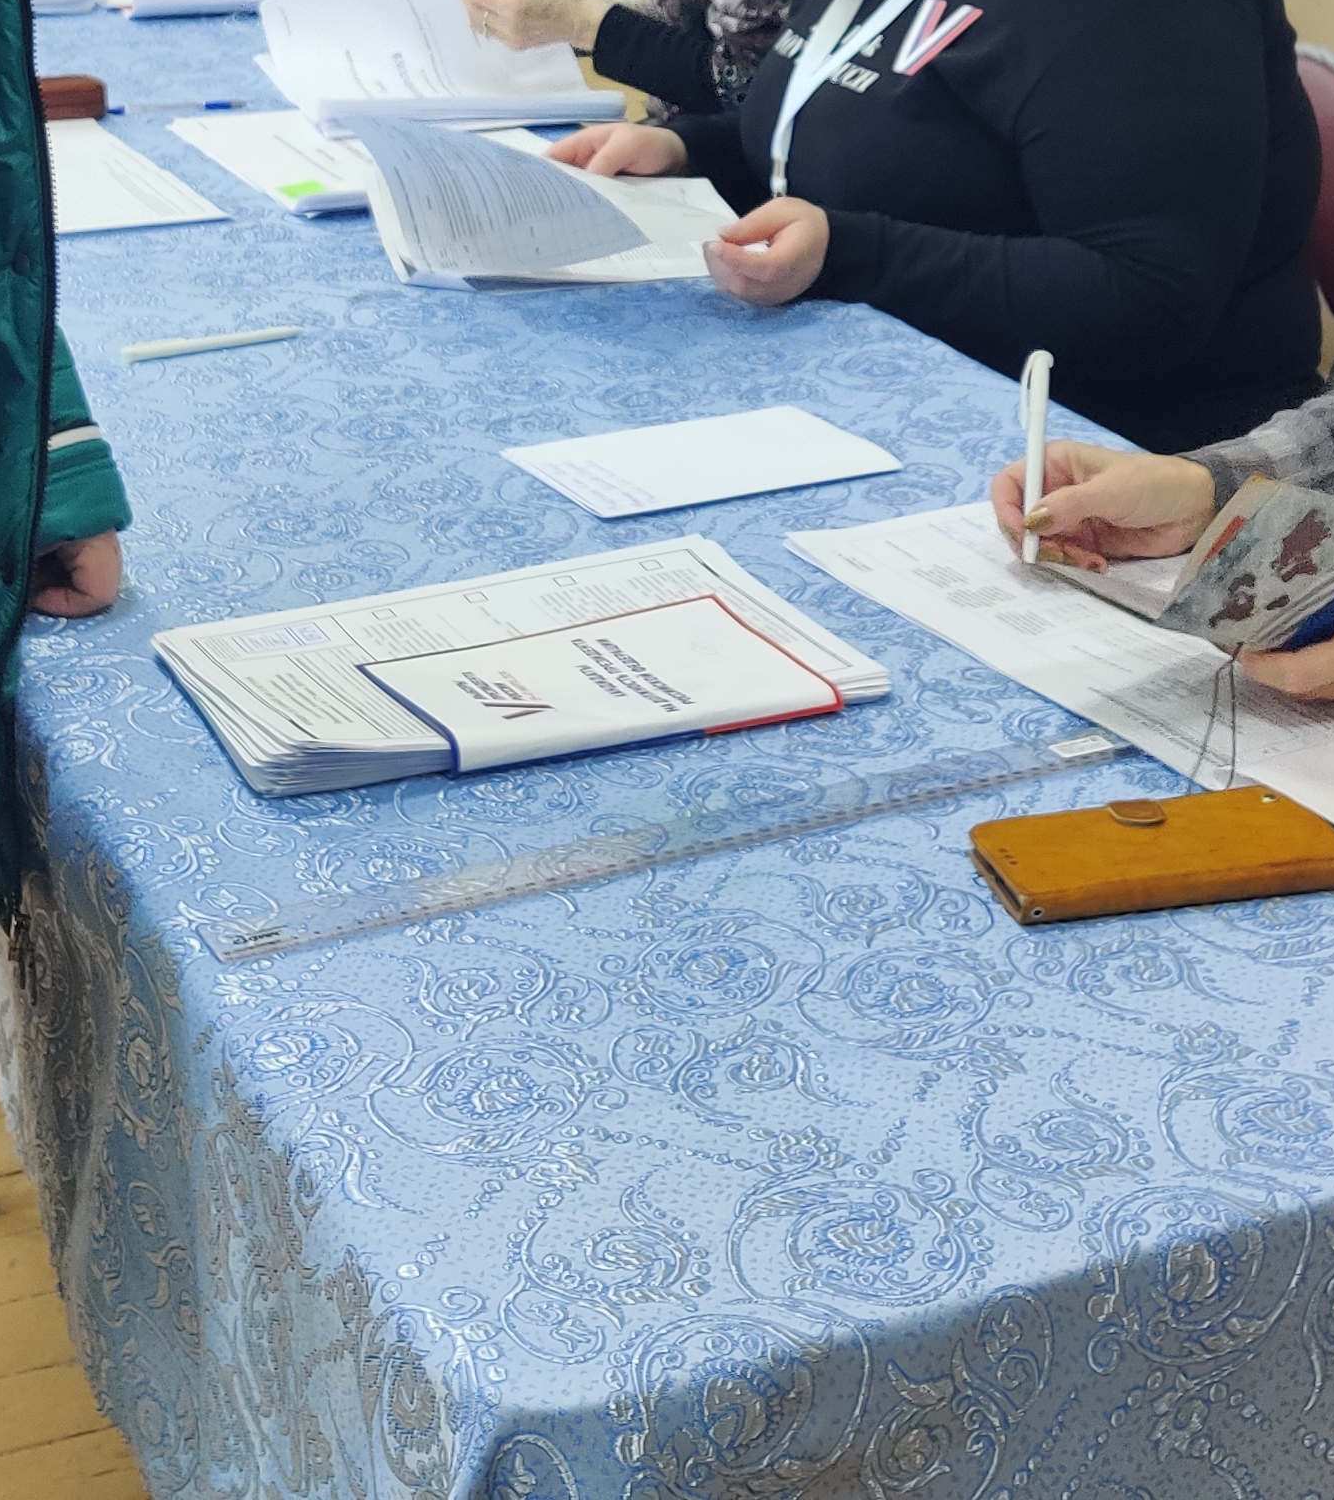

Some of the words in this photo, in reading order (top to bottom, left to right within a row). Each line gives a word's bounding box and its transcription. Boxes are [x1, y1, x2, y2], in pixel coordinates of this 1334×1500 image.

[570, 638, 622, 675] ПРЕЗИДЕНТА
[595, 638, 647, 675] ФЕДЕРАЦИИ
[636, 672, 696, 705] РОССИЙСКОЙ
